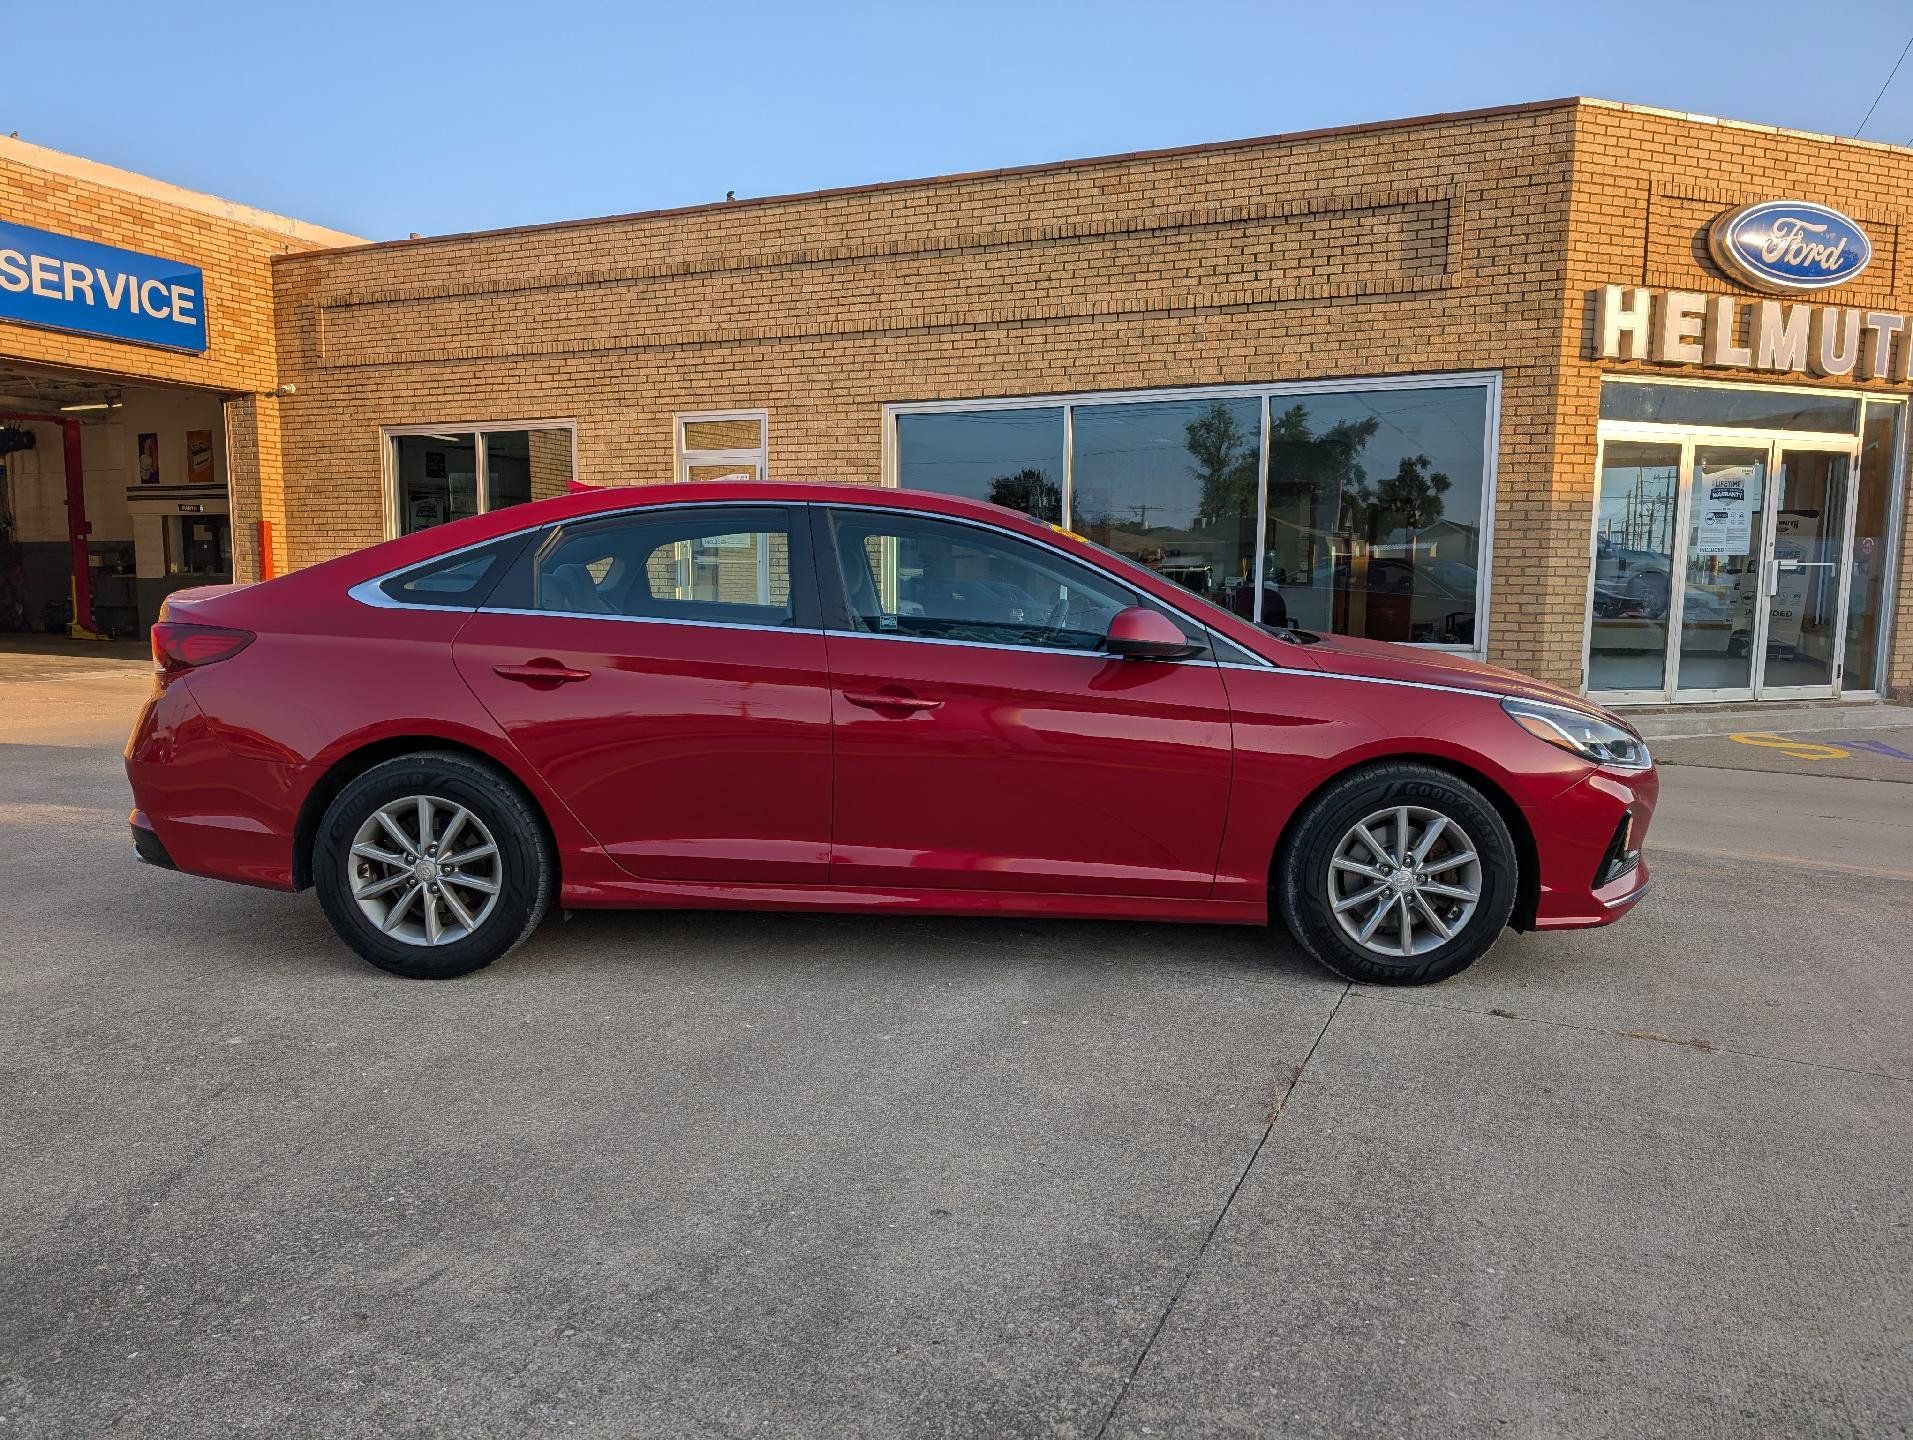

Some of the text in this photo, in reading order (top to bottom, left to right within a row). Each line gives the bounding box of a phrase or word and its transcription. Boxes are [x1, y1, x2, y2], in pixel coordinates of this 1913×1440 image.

[1761, 217, 1848, 271] Ford
[0, 248, 197, 326] SERVICE
[1602, 283, 1913, 381] HELMUT
[1715, 480, 1742, 488] LIFETIME
